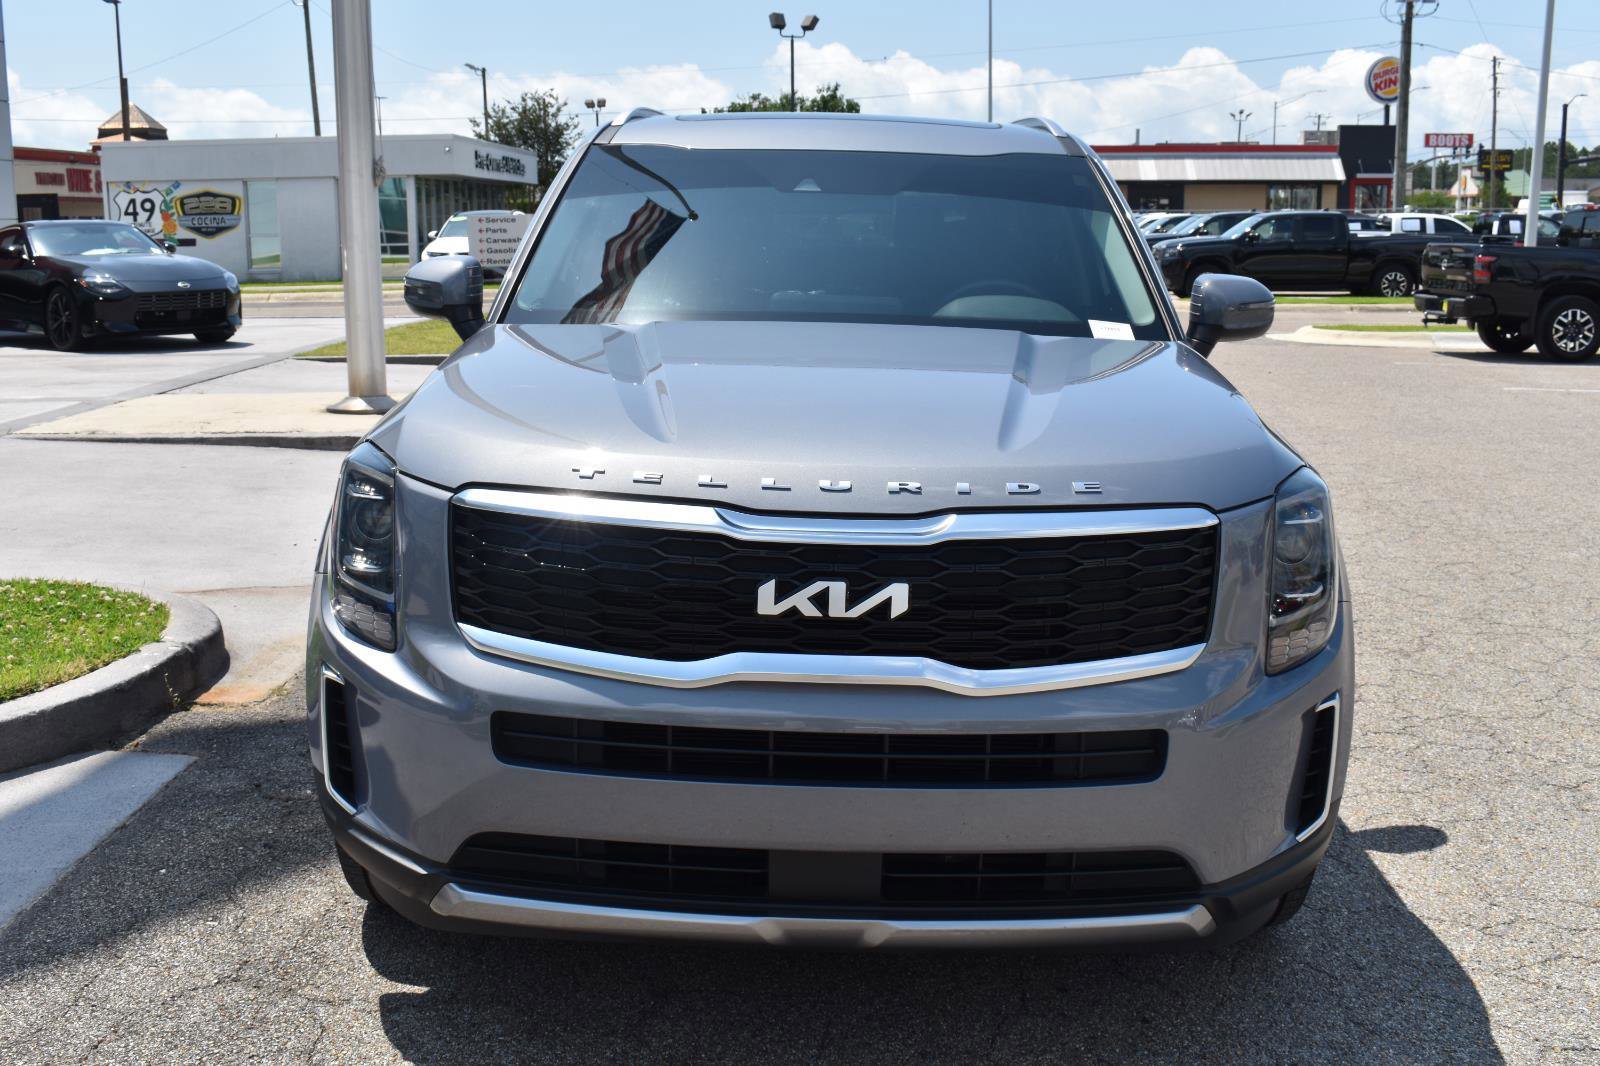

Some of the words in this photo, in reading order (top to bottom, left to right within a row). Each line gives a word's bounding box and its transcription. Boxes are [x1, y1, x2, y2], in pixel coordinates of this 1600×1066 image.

[1373, 65, 1400, 82] BURGE
[1374, 76, 1399, 92] KIN
[1429, 135, 1468, 147] BOOTS
[124, 197, 156, 223] 49
[183, 196, 232, 214] 228
[191, 216, 226, 226] COCINA
[571, 467, 1103, 494] TELLURIDE
[757, 579, 909, 620] KIA
